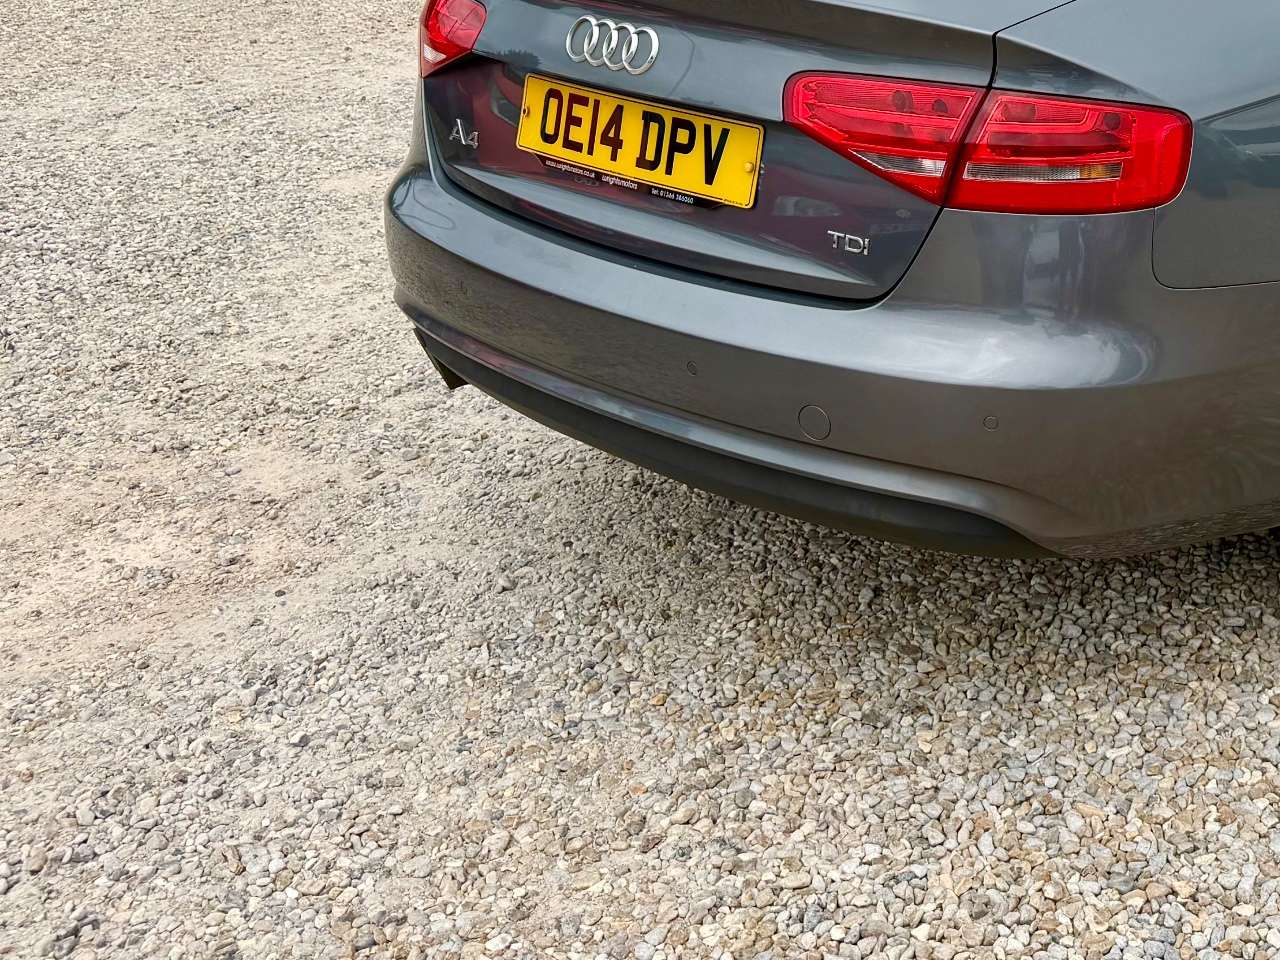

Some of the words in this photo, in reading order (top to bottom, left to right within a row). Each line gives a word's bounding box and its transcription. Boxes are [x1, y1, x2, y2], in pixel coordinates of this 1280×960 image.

[449, 118, 479, 149] A4
[540, 87, 624, 162] OE14
[635, 109, 730, 186] DPV
[827, 230, 870, 255] TDI
